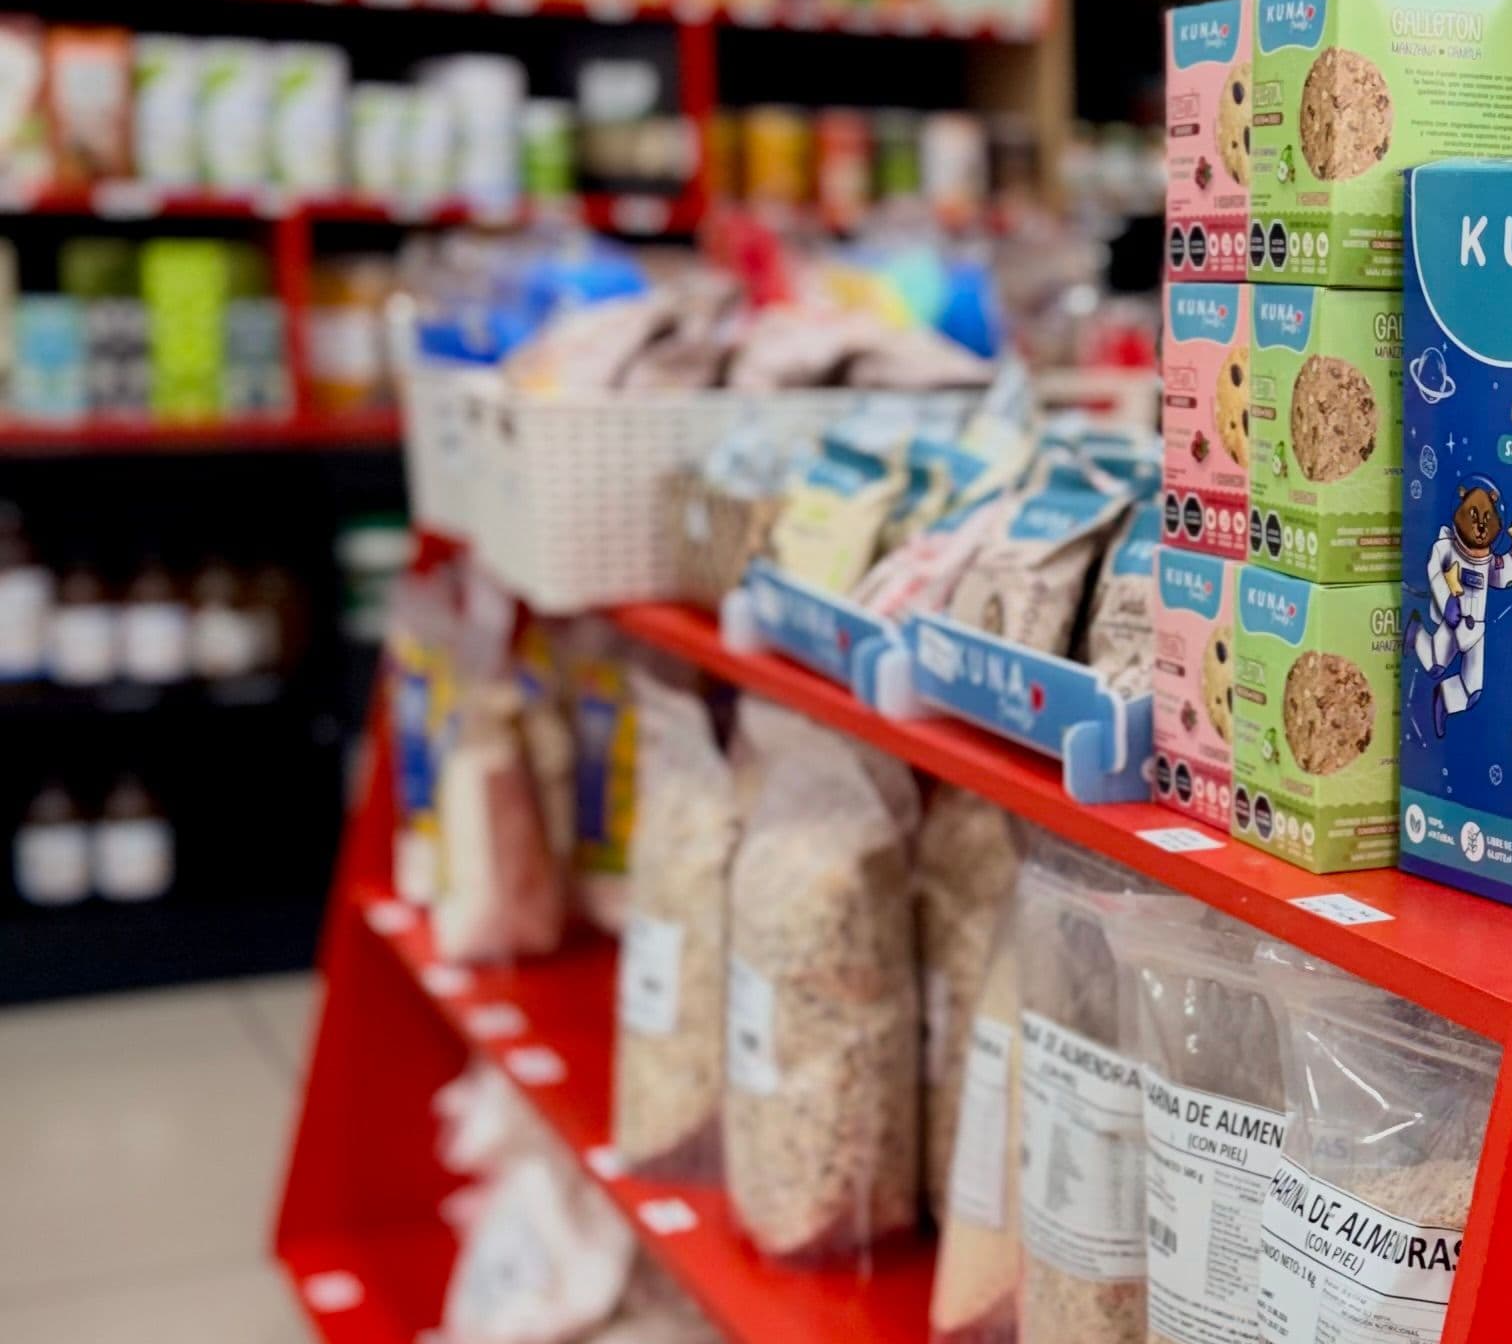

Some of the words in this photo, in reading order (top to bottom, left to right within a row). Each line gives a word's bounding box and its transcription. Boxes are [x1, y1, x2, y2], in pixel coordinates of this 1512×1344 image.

[1266, 0, 1305, 23] KUNA
[1180, 20, 1219, 41] KUNA
[1177, 299, 1216, 316] KUNA
[1261, 304, 1294, 320] KUNA
[1165, 568, 1202, 588] KUNA
[1247, 588, 1286, 609] KUNA
[1060, 1042, 1142, 1090] ALMENDRA
[1186, 1101, 1212, 1127] DE
[1216, 1110, 1284, 1148] ALMEN
[1220, 1144, 1248, 1166] PIEL)
[1308, 1194, 1341, 1231] DE
[1305, 1231, 1329, 1257] (CON
[1333, 1247, 1365, 1276] PIEL)
